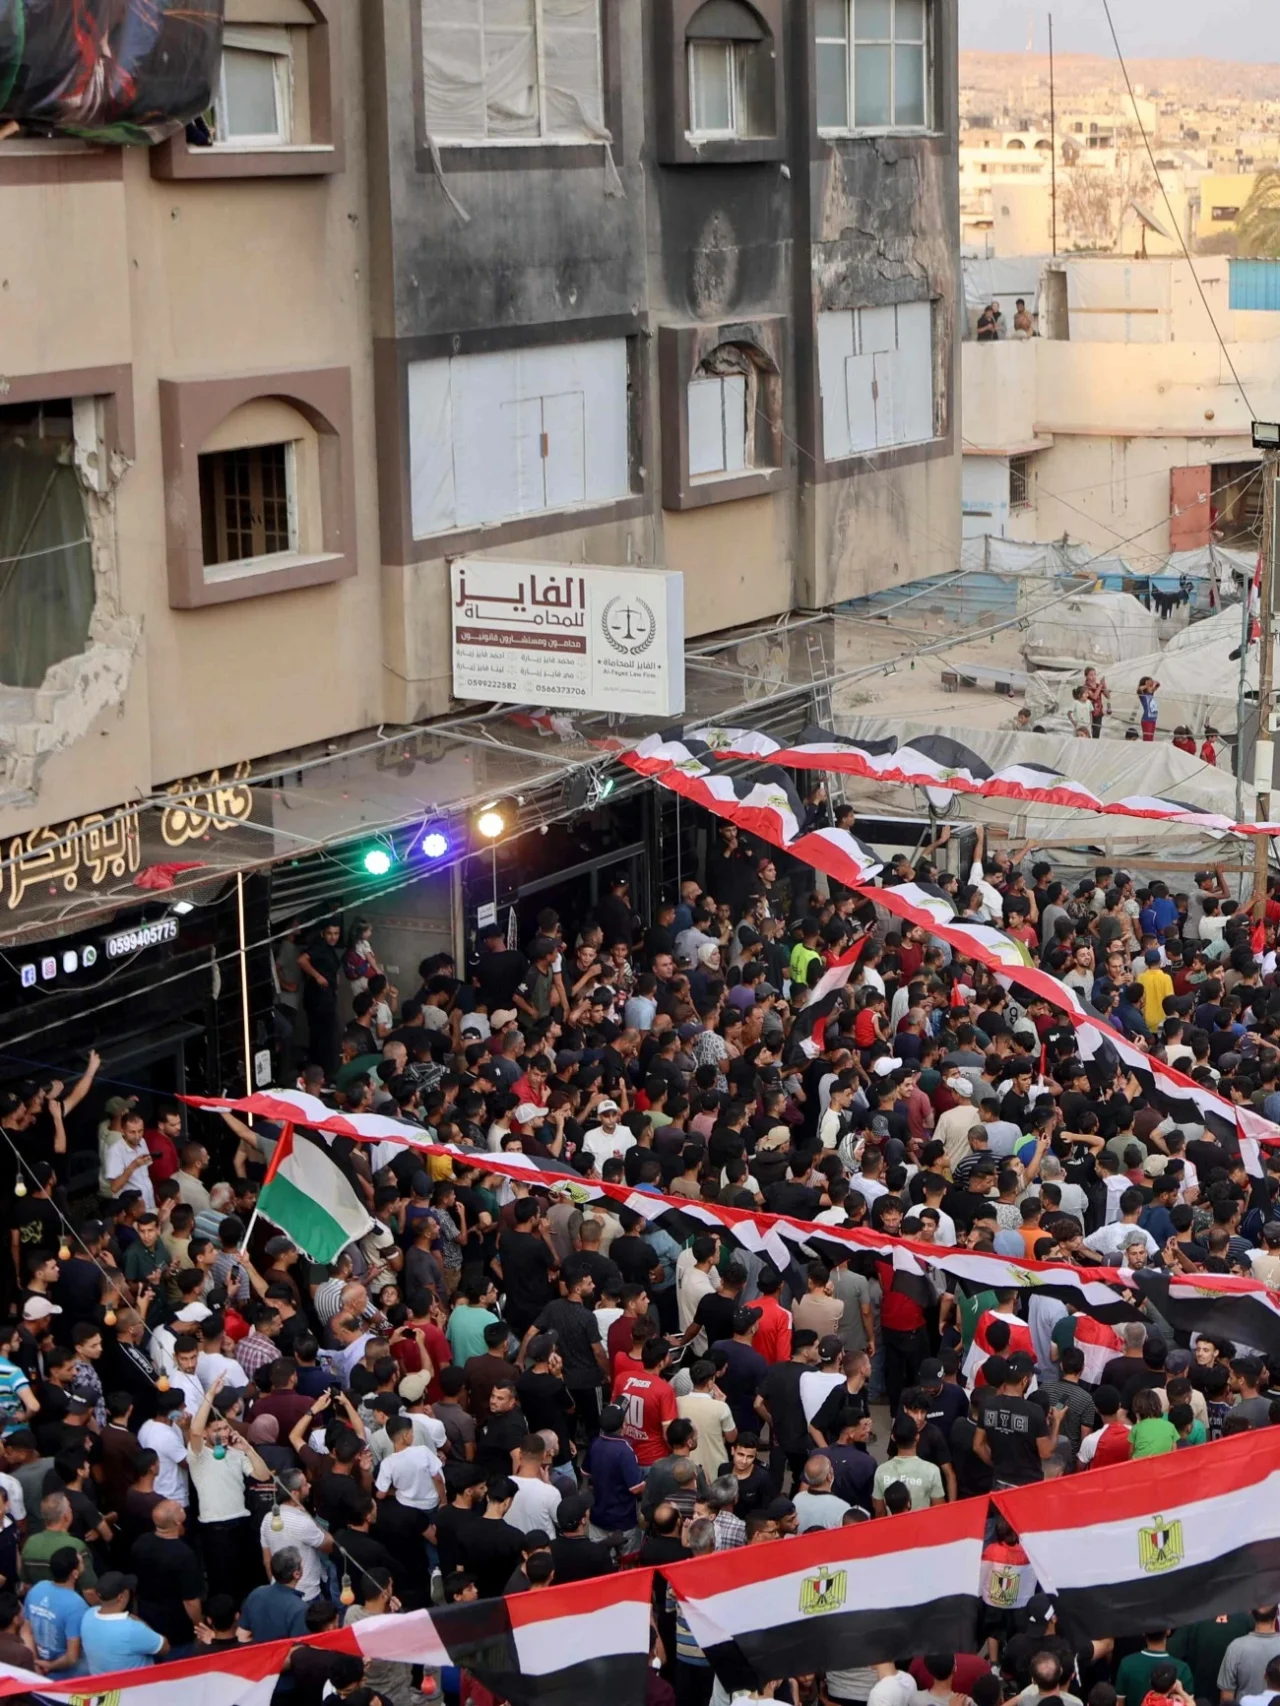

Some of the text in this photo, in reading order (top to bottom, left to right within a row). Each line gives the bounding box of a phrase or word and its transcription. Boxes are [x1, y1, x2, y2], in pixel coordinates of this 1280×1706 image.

[455, 569, 585, 613] الفايز
[467, 679, 586, 696] 0599222582 0566373706
[108, 921, 178, 956] 0599405775
[900, 1475, 923, 1486] Free
